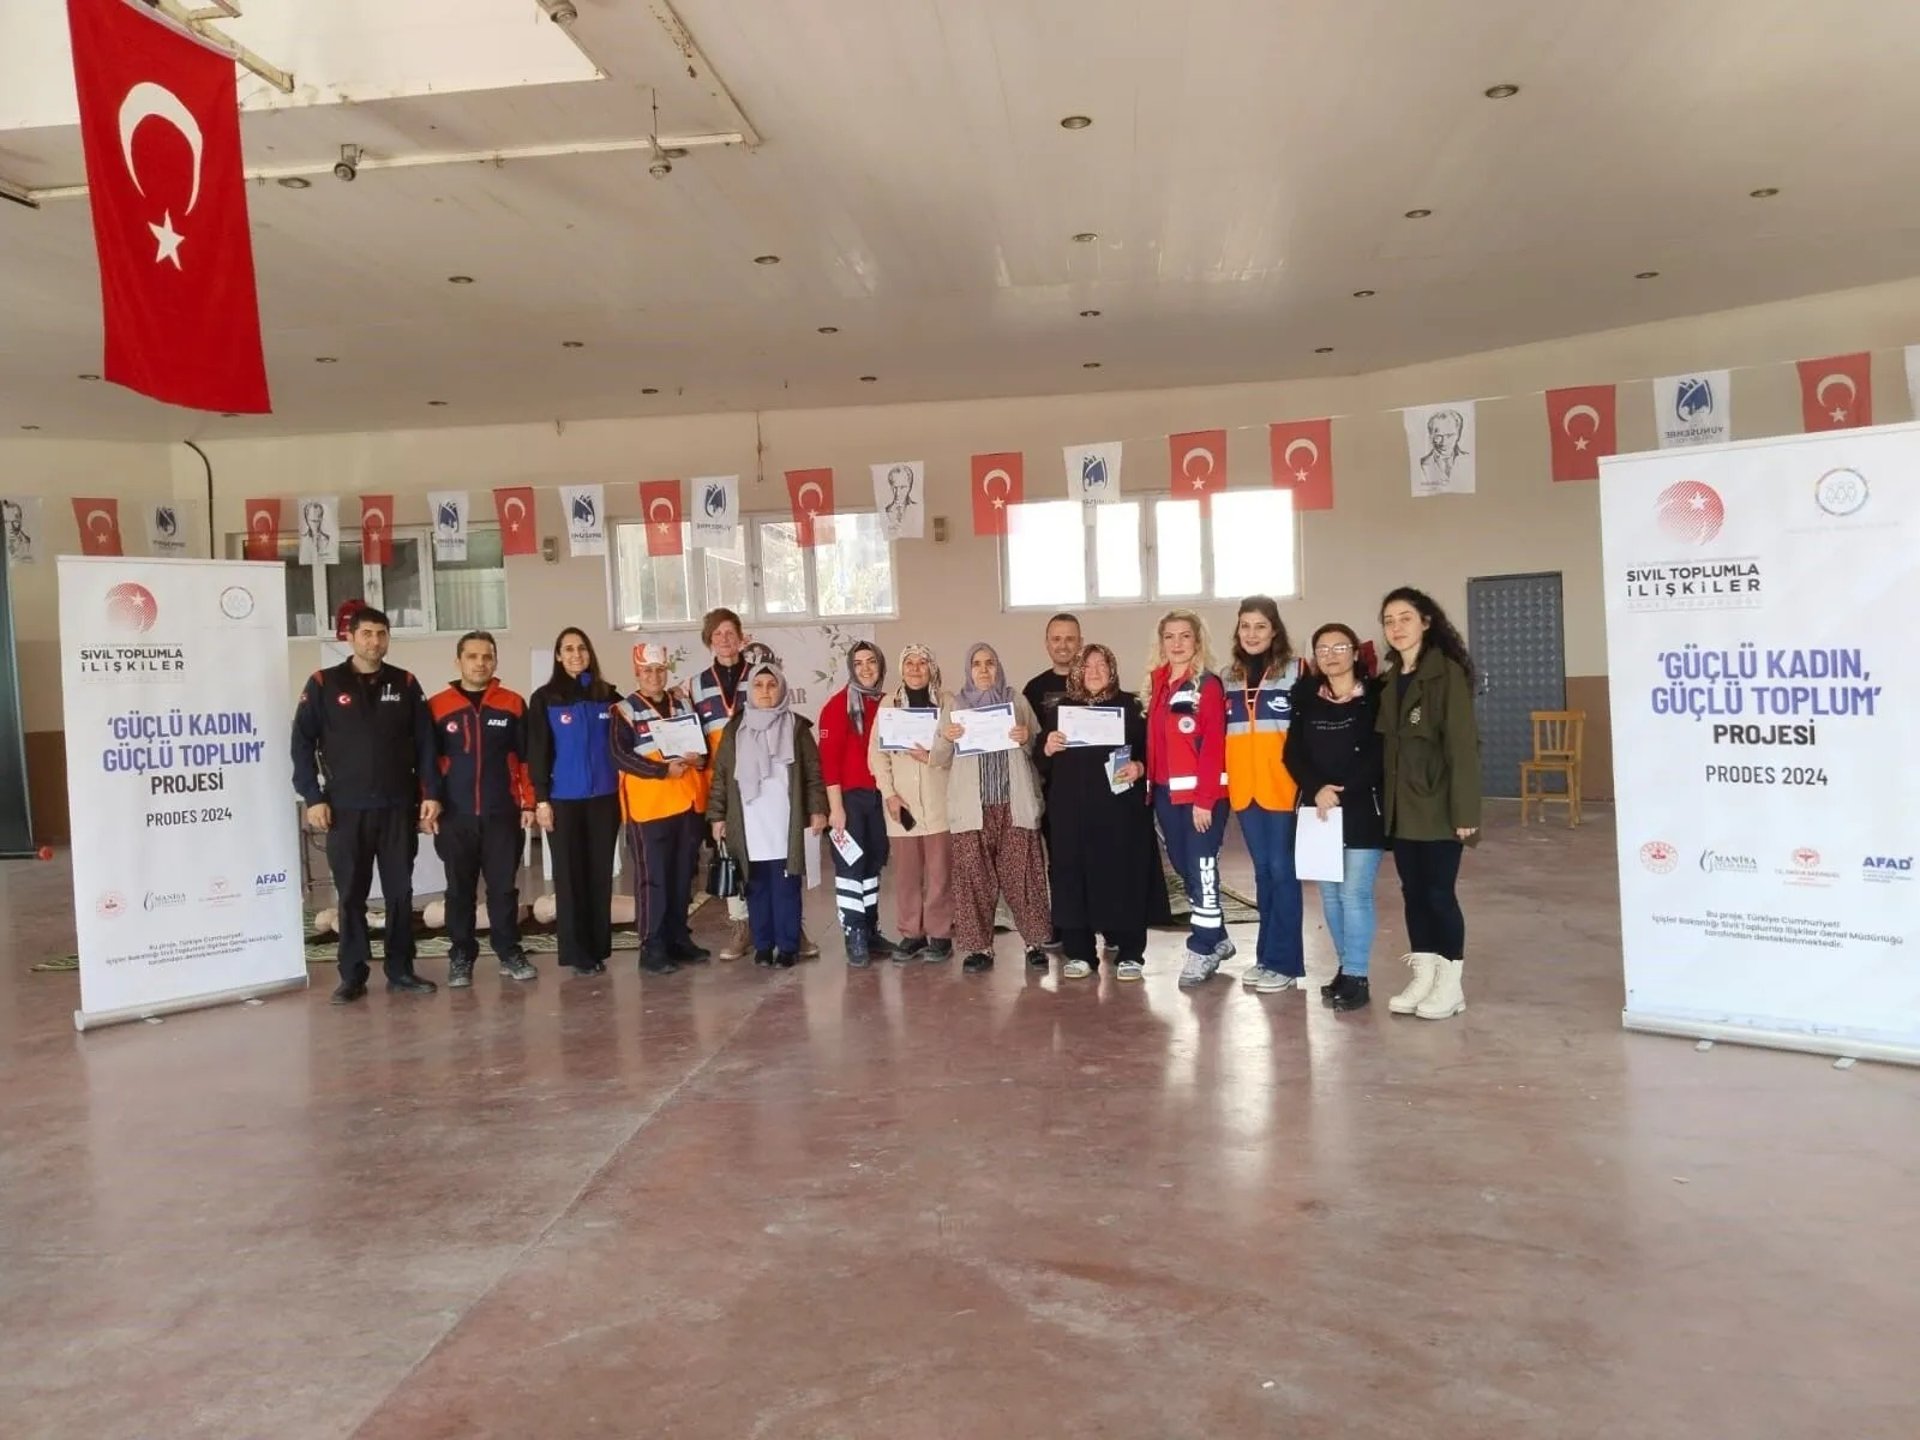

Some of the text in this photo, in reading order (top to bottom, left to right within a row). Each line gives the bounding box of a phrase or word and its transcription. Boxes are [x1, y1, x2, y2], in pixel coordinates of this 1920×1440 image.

[1669, 563, 1760, 579] TOPLUMLA
[117, 648, 183, 660] TOPLUMLA
[1766, 648, 1870, 682] KADIN,
[1651, 681, 1743, 722] GÜÇLÜ
[188, 711, 258, 737] KADIN,
[1713, 718, 1816, 746] PROJESİ
[103, 740, 173, 776] GÜÇLÜ
[151, 767, 224, 795] PROJESİ
[1705, 764, 1829, 787] PRODES 2024
[146, 806, 233, 827] PRODES 2024
[1862, 856, 1911, 870] AFAD
[256, 872, 286, 886] AFAD
